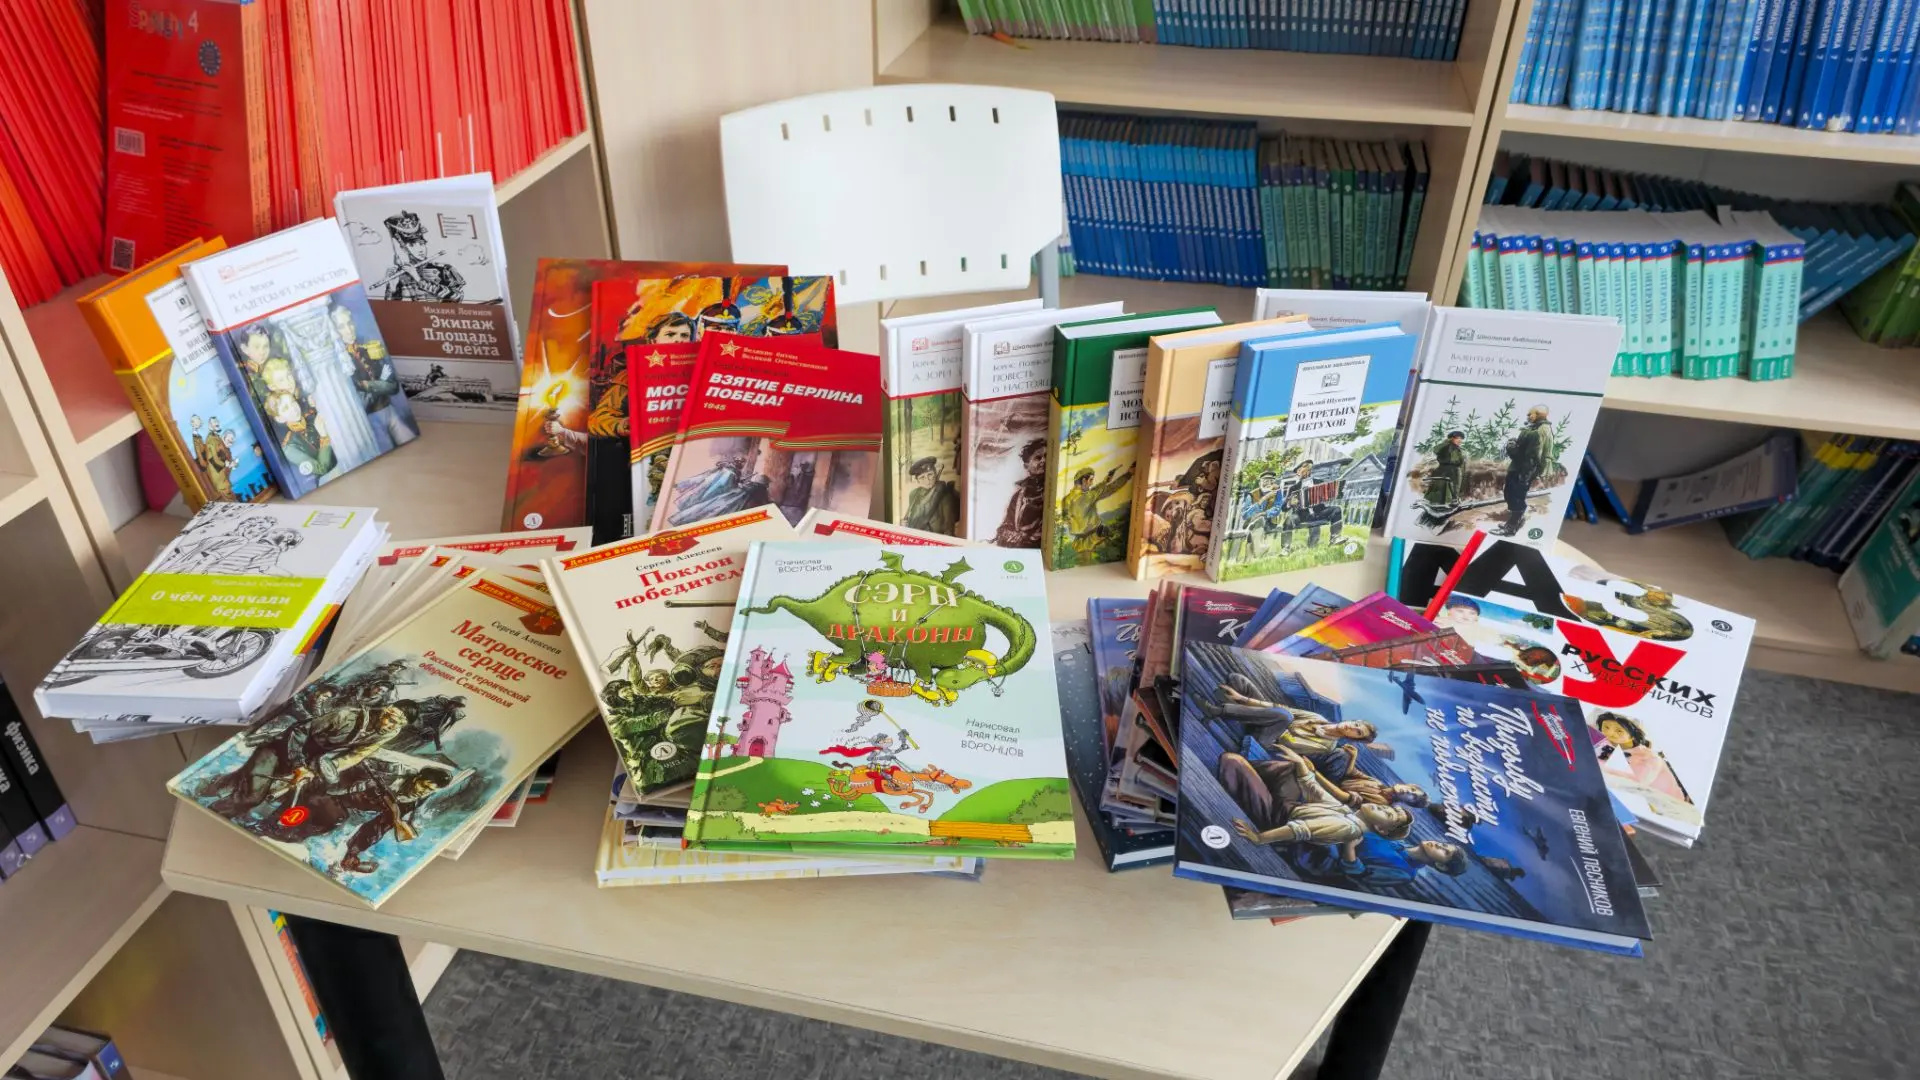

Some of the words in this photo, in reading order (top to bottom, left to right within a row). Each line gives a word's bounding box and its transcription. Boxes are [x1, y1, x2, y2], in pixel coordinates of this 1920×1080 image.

[430, 315, 495, 330] Экипаж
[422, 328, 497, 345] Площадь
[442, 341, 500, 356] Флейта
[993, 370, 1034, 383] ПОВЕСТЬ
[1447, 365, 1473, 376] СЫН
[1477, 367, 1517, 379] ПОЛКА
[705, 386, 784, 407] ПОБЕДА!
[709, 372, 778, 393] ВЗЯТИЕ
[782, 383, 863, 405] БЕРЛИНА
[703, 402, 726, 411] 1945
[1297, 399, 1326, 408] Василий
[1326, 396, 1357, 405] Шукшин
[1291, 413, 1306, 423] ДО
[1308, 406, 1357, 419] ТРЕТЬИХ
[1297, 418, 1347, 432] ПЕТУХОВ
[524, 536, 559, 546] России
[570, 553, 602, 566] Детям
[613, 538, 656, 554] Великой
[658, 519, 734, 543] Отечественной
[735, 512, 765, 526] войне
[837, 521, 869, 532] Детям
[879, 531, 920, 545] великих
[635, 558, 672, 572] Сергей
[676, 546, 723, 562] Алексеев
[774, 558, 822, 566] Станислав
[778, 565, 832, 573] ВОСТОКОВ
[638, 557, 734, 588] Поклон
[151, 591, 165, 601] О
[169, 591, 205, 602] чём
[208, 594, 291, 605] молчали
[844, 583, 960, 607] СЭРЫ
[212, 606, 282, 620] берёзы
[491, 620, 521, 638] Сергей
[522, 634, 562, 656] Алексеев
[827, 623, 974, 644] ДРАКОНЫ
[450, 619, 568, 681] Матросское
[458, 646, 527, 682] сердце
[419, 662, 455, 682] обороне
[456, 676, 514, 708] Севастополя
[423, 650, 465, 676] Рассказы
[473, 673, 532, 704] героической
[1561, 642, 1718, 710] РУССКИХ
[1569, 659, 1715, 719] ХУДОЖНИКОВ
[966, 718, 1021, 734] Нарисовал
[1425, 707, 1449, 732] не
[1455, 705, 1478, 729] по
[4, 720, 40, 776] физика
[961, 739, 1024, 758] ВОРОНЦОВ
[993, 733, 1018, 744] Коля
[1481, 702, 1545, 801] Призыву
[1455, 731, 1500, 826] возрасту
[1430, 735, 1476, 845] подлежит
